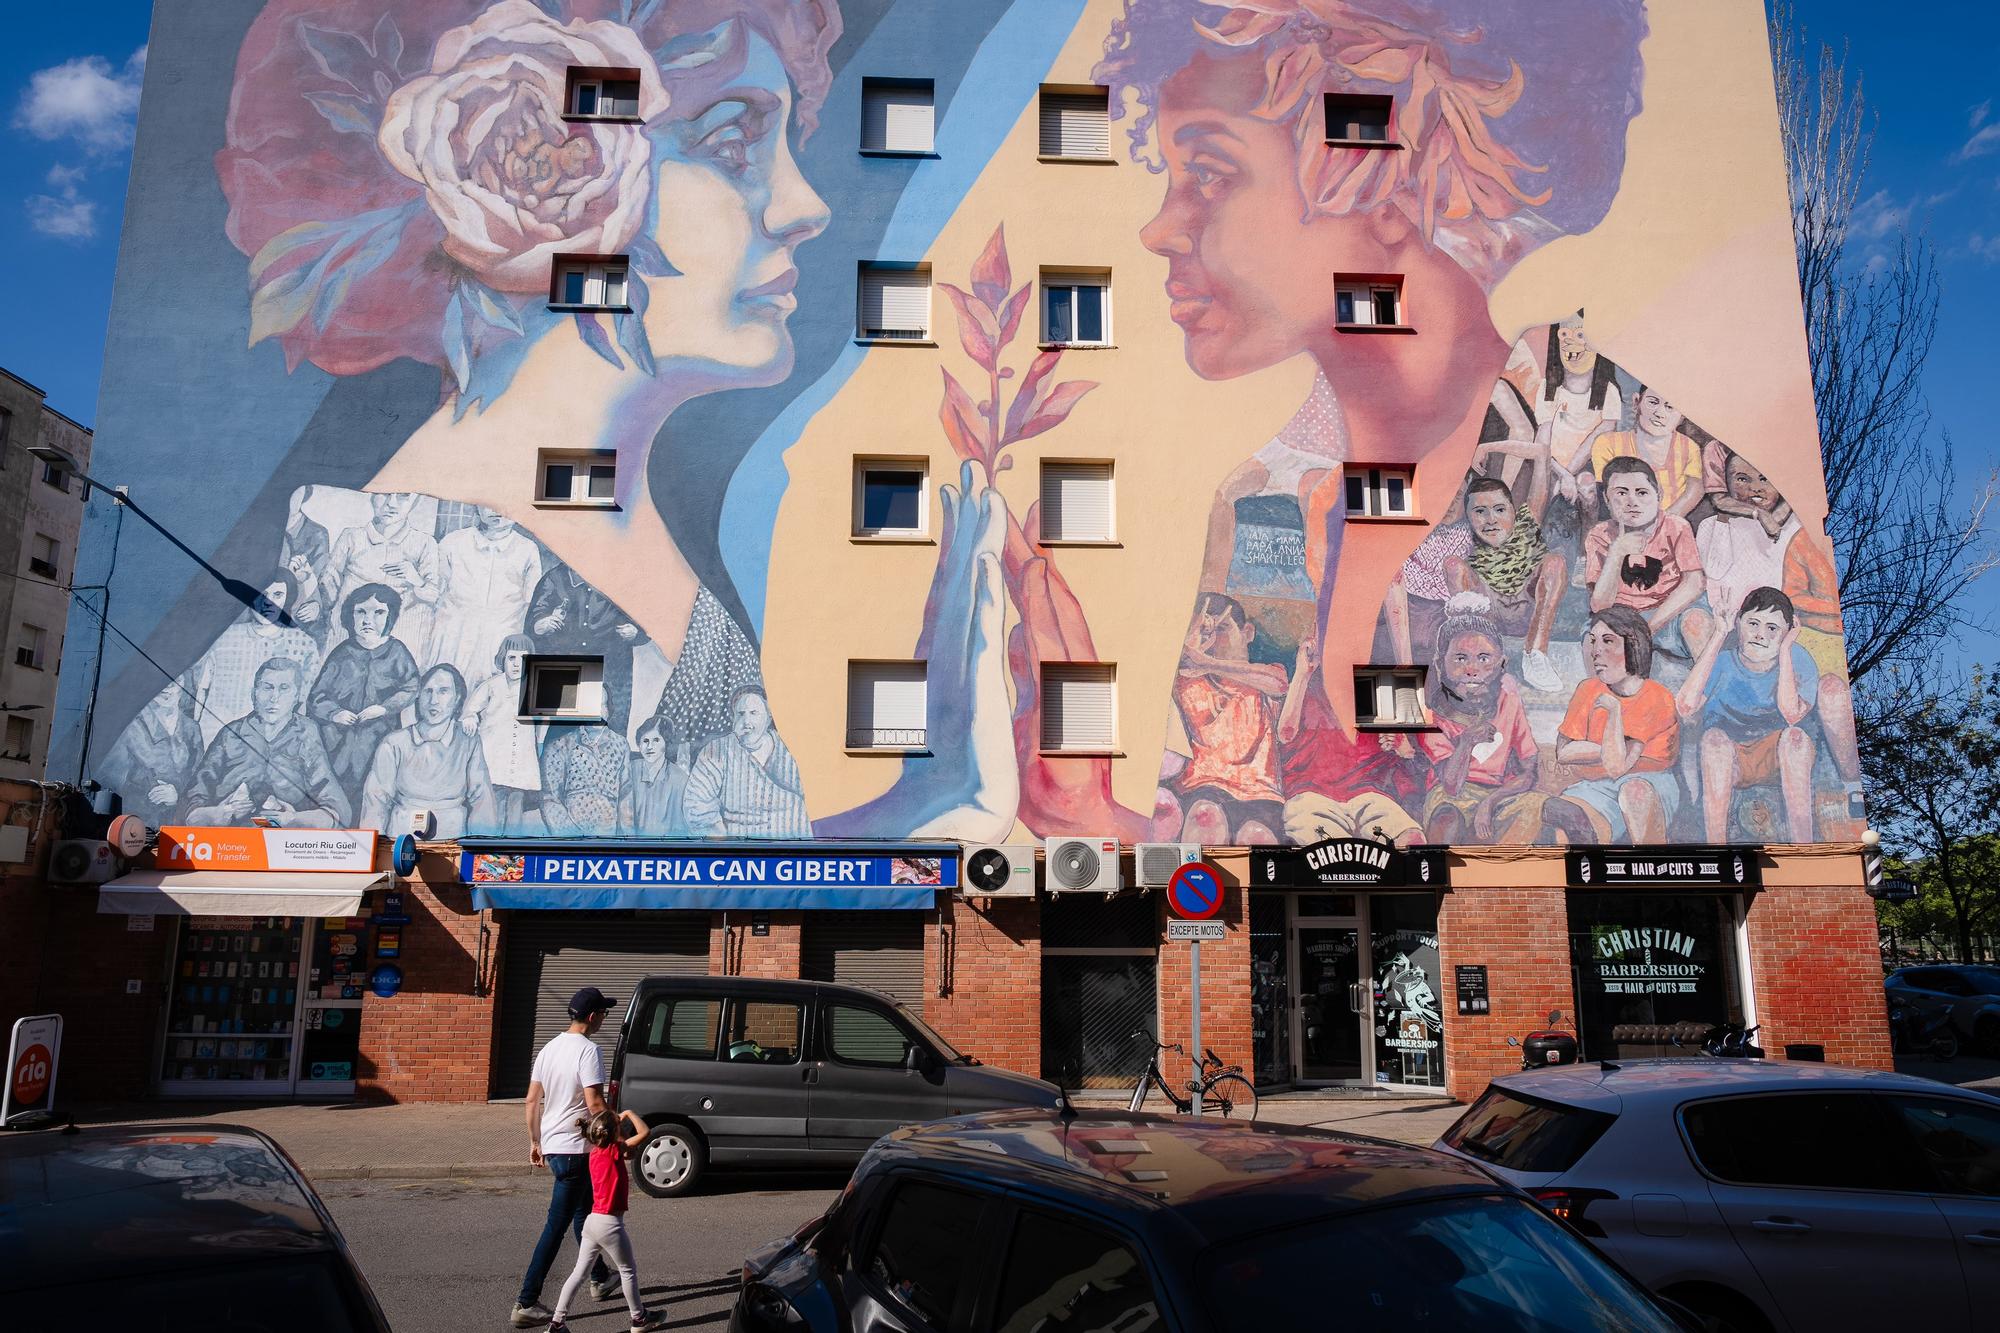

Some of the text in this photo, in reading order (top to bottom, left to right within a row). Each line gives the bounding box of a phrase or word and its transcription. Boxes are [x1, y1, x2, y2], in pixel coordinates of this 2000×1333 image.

[170, 833, 213, 860] ria
[217, 843, 247, 853] Money
[285, 841, 357, 849] Locutori Riu Güell
[216, 853, 251, 861] Transfer
[1306, 843, 1391, 870] CHRISTIAN
[544, 859, 872, 881] PEIXATERIA CAN GIBERT
[1631, 863, 1655, 876] HAIR
[1669, 863, 1694, 876] CUTS
[1322, 873, 1377, 881] BARBERSHOP
[1170, 925, 1224, 936] EXCEPTE MOTOS
[1375, 934, 1439, 950] SUPPORT YOUR
[1598, 927, 1696, 958] CHRISTIAN
[1600, 964, 1699, 976] BARBERSHOP
[1624, 982, 1645, 993] HAIR
[1656, 982, 1677, 993] CUTS
[1399, 1030, 1423, 1039] LOCAL
[1385, 1039, 1438, 1048] BARBERSHOP
[19, 1053, 46, 1084] ria
